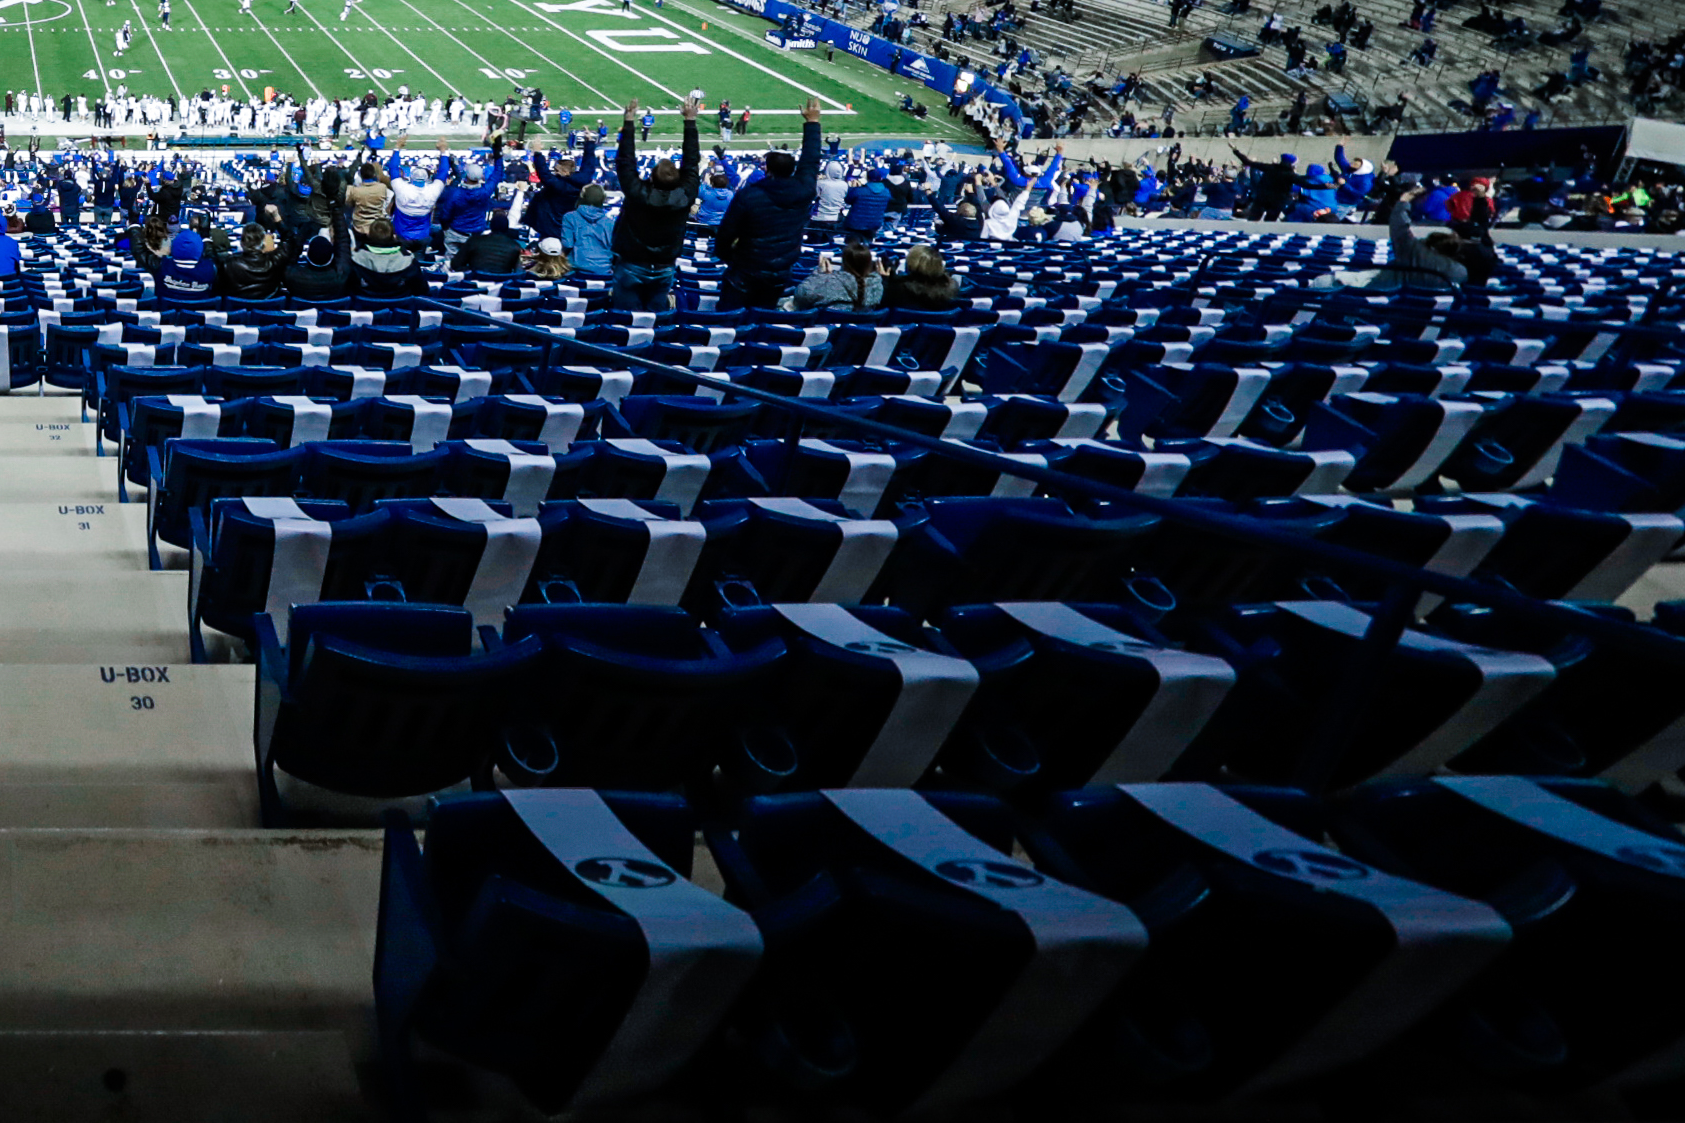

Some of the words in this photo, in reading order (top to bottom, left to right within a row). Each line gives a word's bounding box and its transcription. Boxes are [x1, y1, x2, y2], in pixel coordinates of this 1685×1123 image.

[850, 30, 863, 42] NU
[848, 41, 868, 57] SKIN
[82, 68, 127, 80] 40
[212, 68, 259, 80] 30
[343, 67, 393, 80] 20
[478, 67, 527, 79] 10
[58, 505, 105, 515] U-BOX
[78, 522, 90, 531] 31
[99, 666, 171, 685] U-BOX
[130, 695, 155, 711] 30
